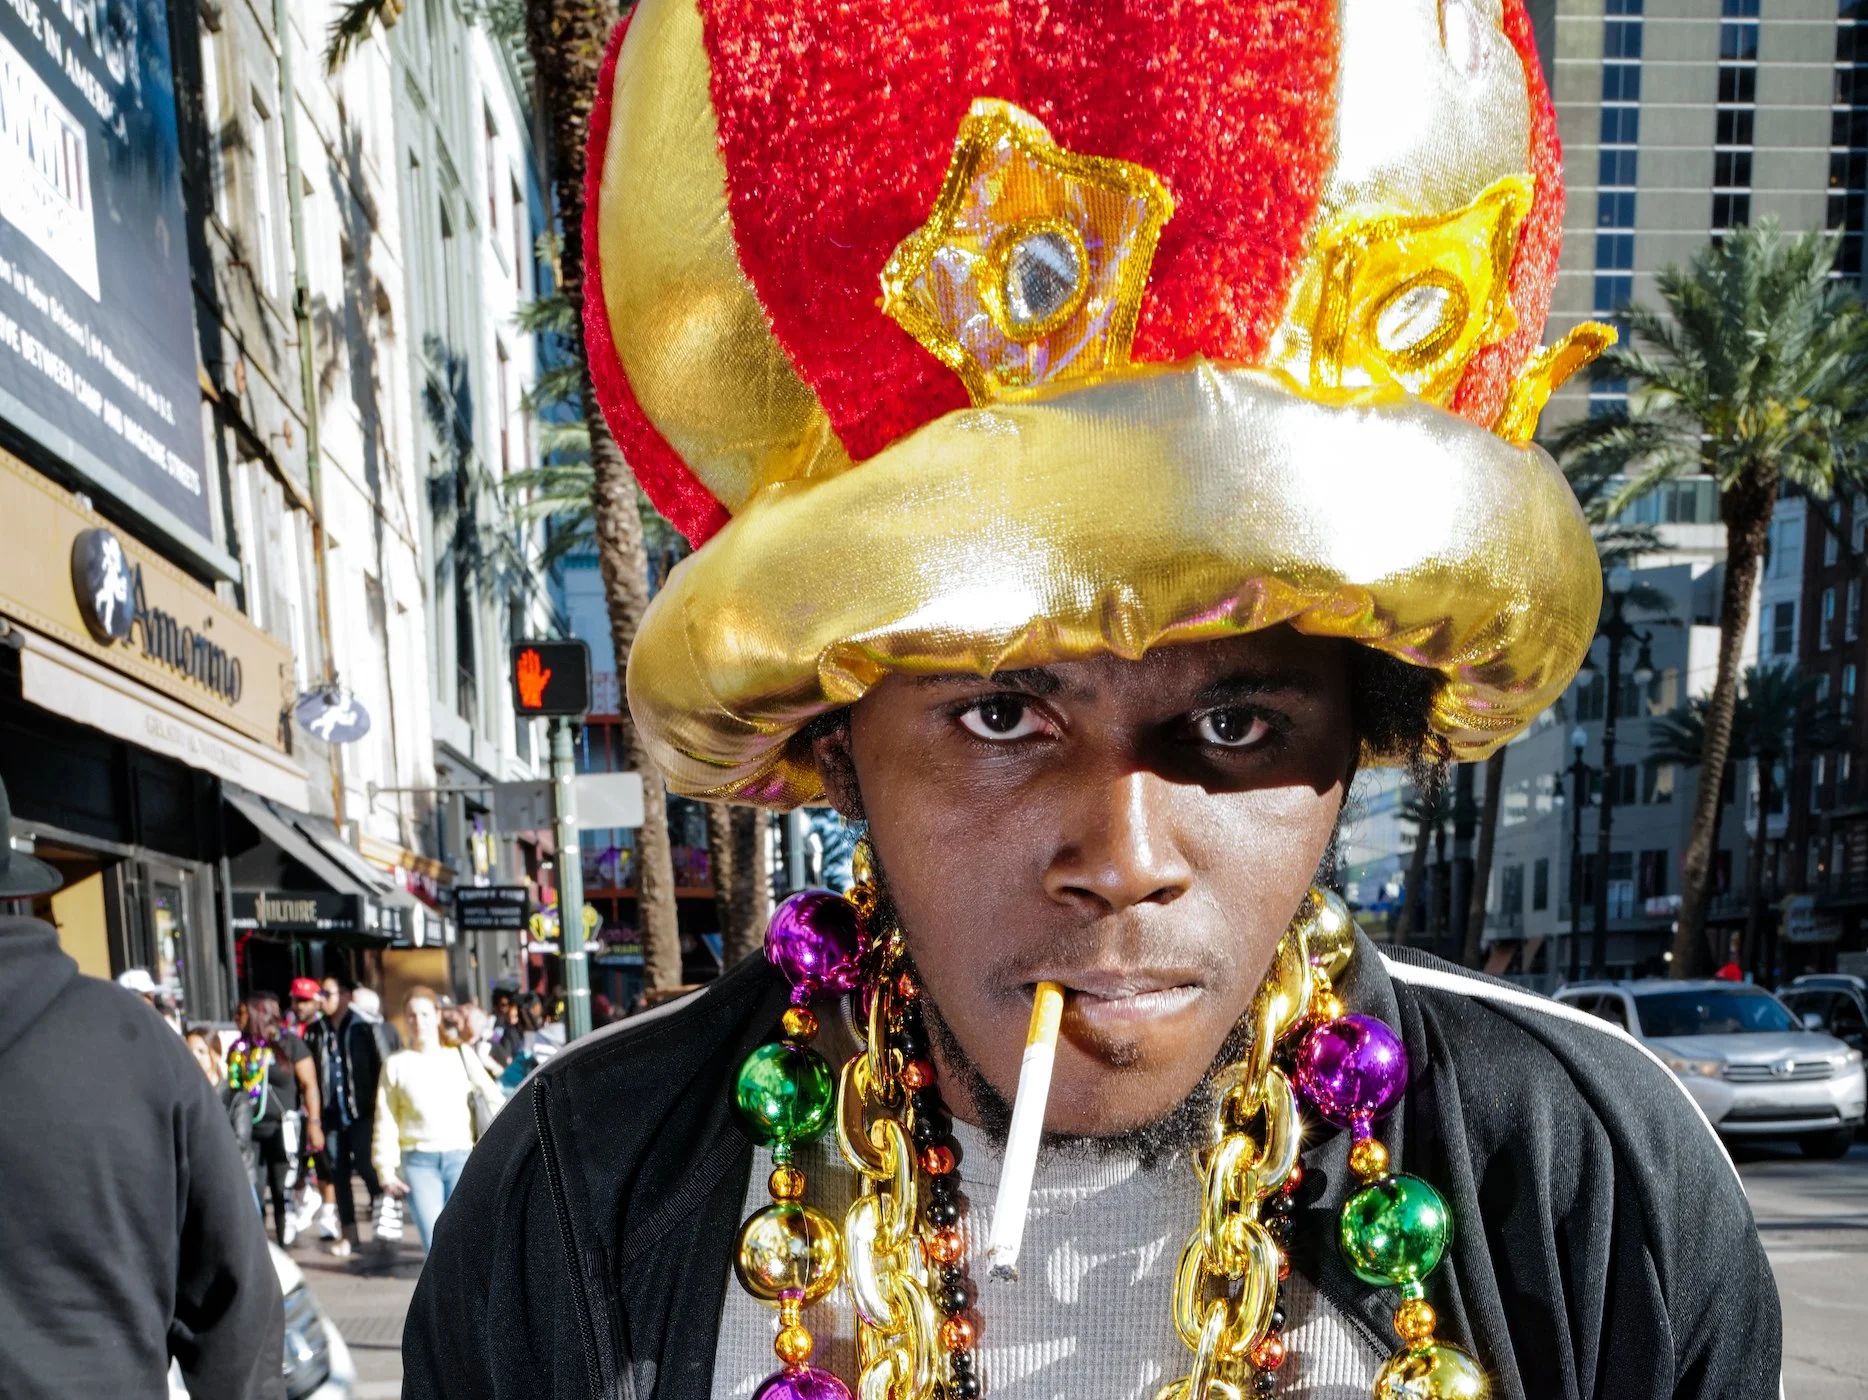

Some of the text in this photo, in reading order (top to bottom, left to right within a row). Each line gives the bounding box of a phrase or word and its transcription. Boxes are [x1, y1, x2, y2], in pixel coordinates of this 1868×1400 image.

[43, 16, 63, 67] IN
[20, 328, 75, 397] BETWEEN
[122, 563, 242, 707] Amorino
